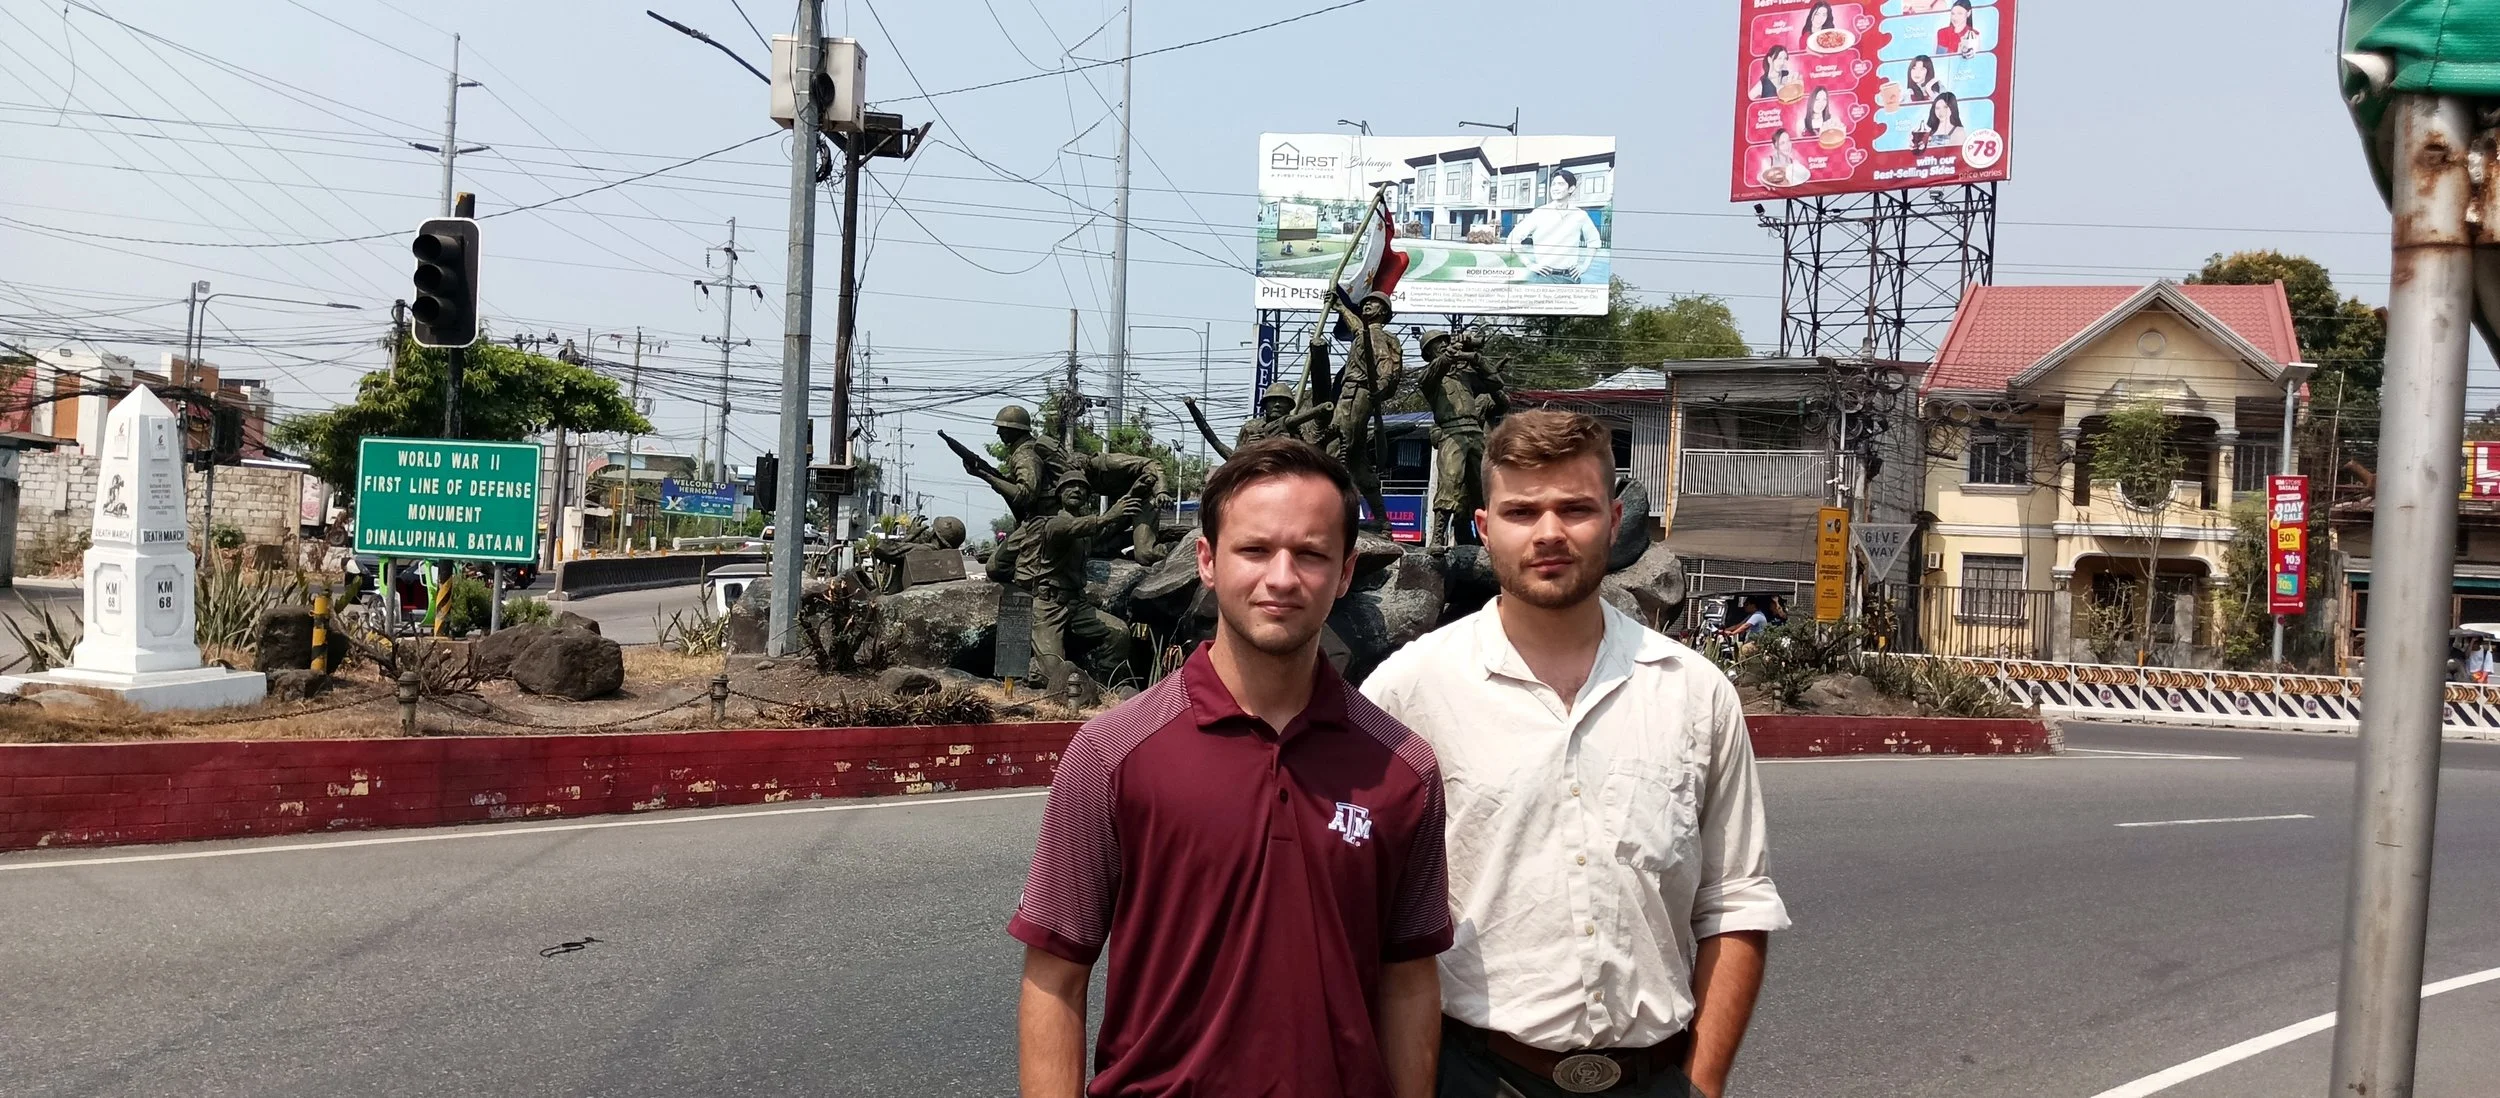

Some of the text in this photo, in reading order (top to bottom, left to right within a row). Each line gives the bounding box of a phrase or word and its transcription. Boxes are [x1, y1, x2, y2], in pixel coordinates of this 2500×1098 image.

[1916, 156, 1956, 167] with our
[1873, 165, 1955, 180] Best-Selling Sides
[1979, 169, 2002, 178] varies
[1262, 286, 1286, 299] PH1
[398, 450, 500, 471] WORLD WAR II
[364, 475, 532, 499] FIRST LINE OF DEFENSE
[672, 479, 713, 489] WELCOME
[679, 487, 718, 496] HERMOSA
[2284, 501, 2304, 513] DAY
[408, 504, 482, 523] MONUMENT
[2283, 512, 2304, 521] SALE
[95, 529, 129, 539] DEATH MARCH
[143, 529, 184, 543] DEATH MARCH
[1865, 532, 1900, 543] GIVE
[468, 533, 524, 552] BATAAN
[1869, 547, 1895, 557] WAY
[105, 582, 118, 595] KM
[157, 581, 173, 594] KM
[108, 596, 115, 608] 68
[159, 597, 172, 609] 68
